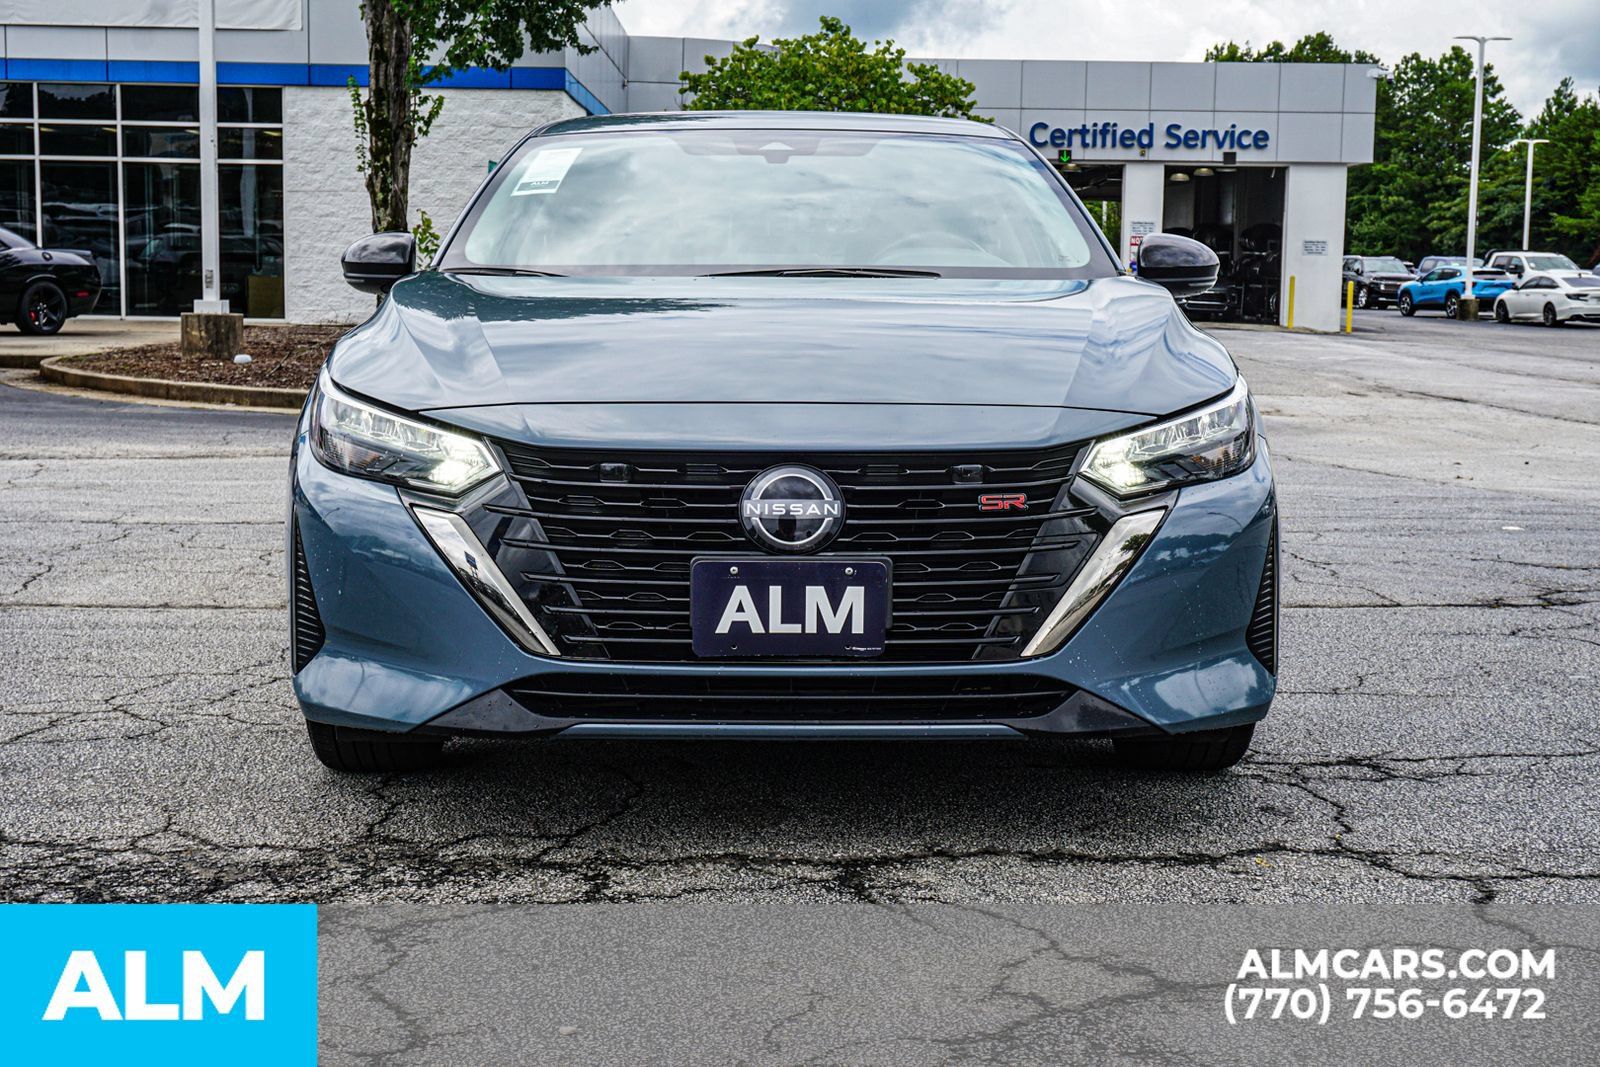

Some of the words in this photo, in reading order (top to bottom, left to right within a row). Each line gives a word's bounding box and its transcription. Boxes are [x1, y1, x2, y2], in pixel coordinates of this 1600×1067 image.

[1029, 121, 1154, 149] Certified
[1165, 123, 1270, 150] Service
[745, 502, 840, 517] NISSAN
[979, 493, 1027, 511] SR
[714, 585, 865, 634] ALM
